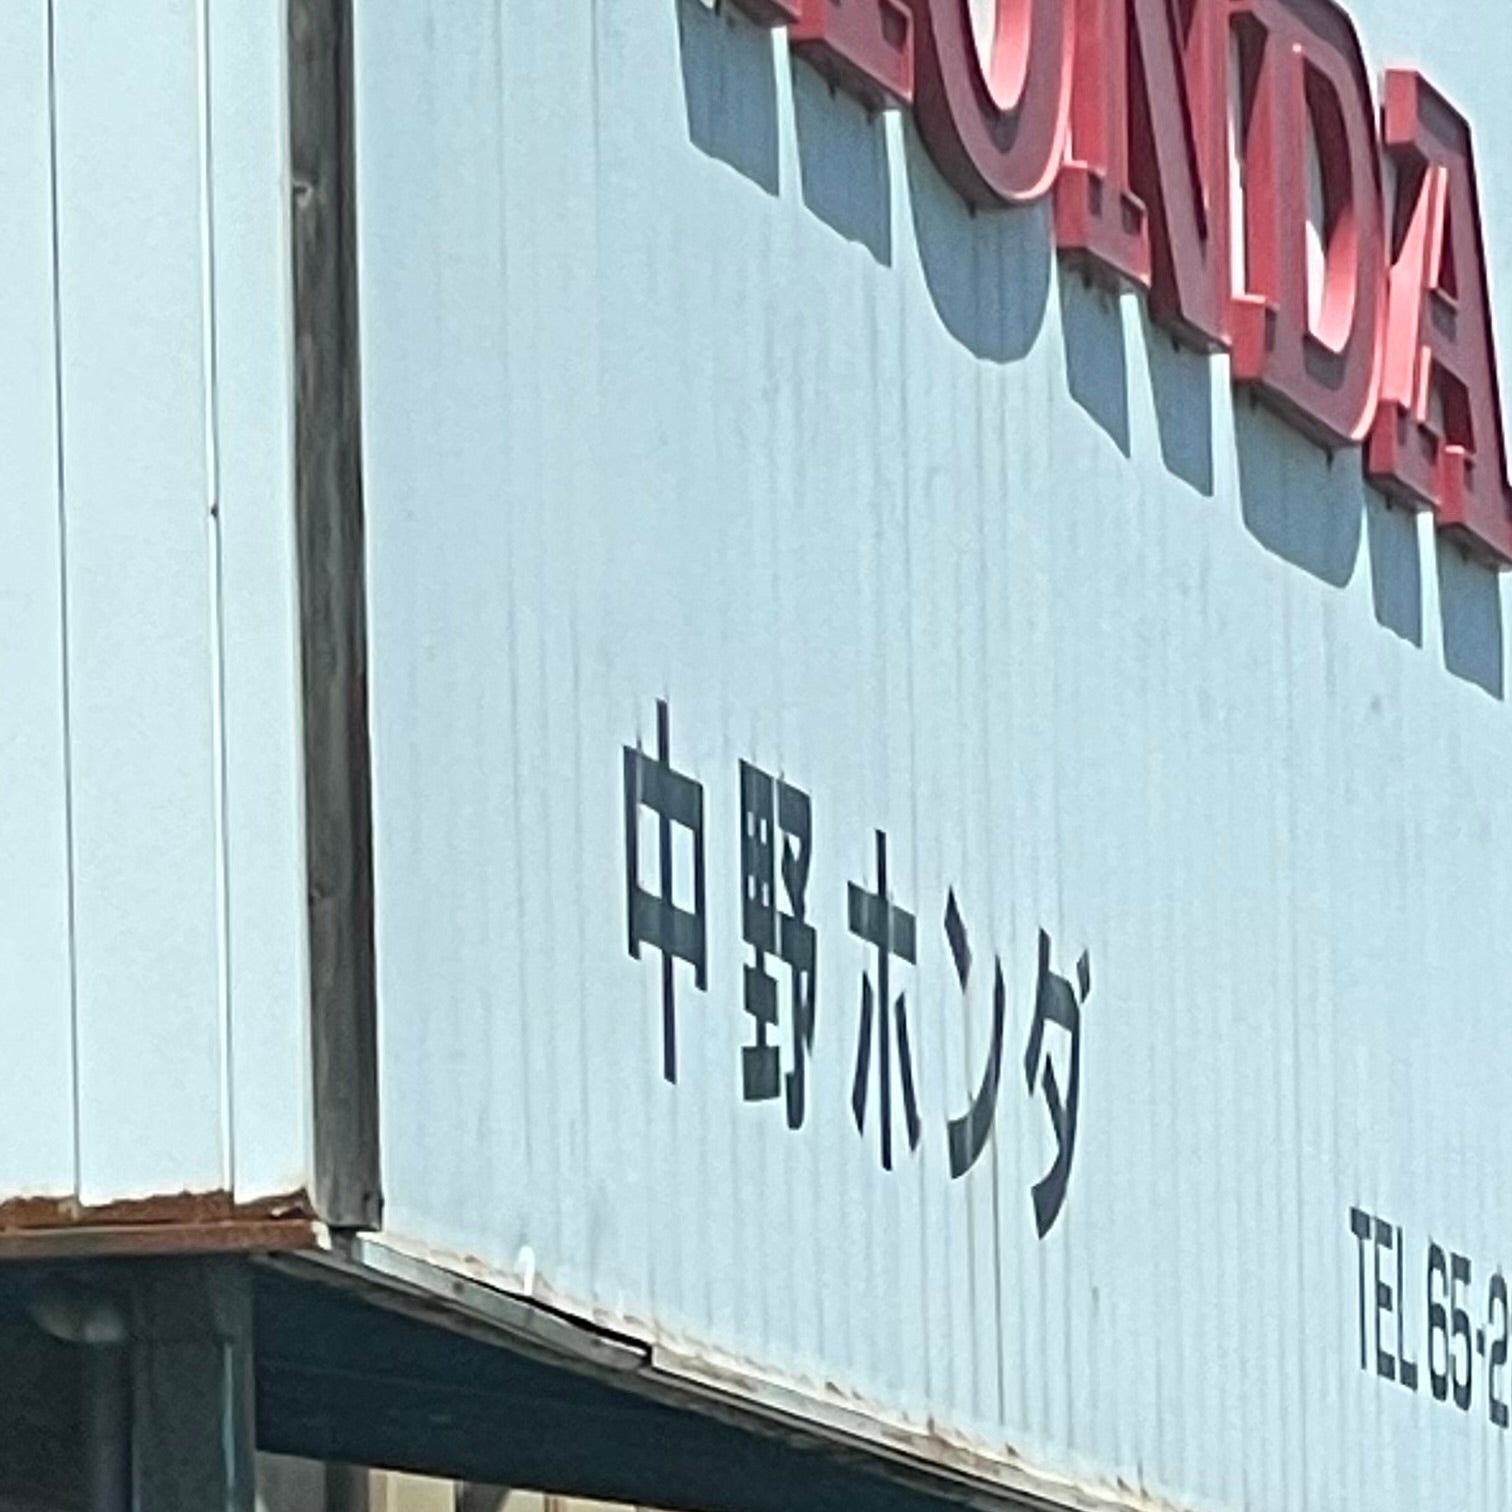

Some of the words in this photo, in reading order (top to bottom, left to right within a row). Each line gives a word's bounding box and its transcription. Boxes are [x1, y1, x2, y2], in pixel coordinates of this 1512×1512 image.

[623, 698, 1091, 1241] 中野ホンダ
[1350, 1205, 1418, 1391] TEL
